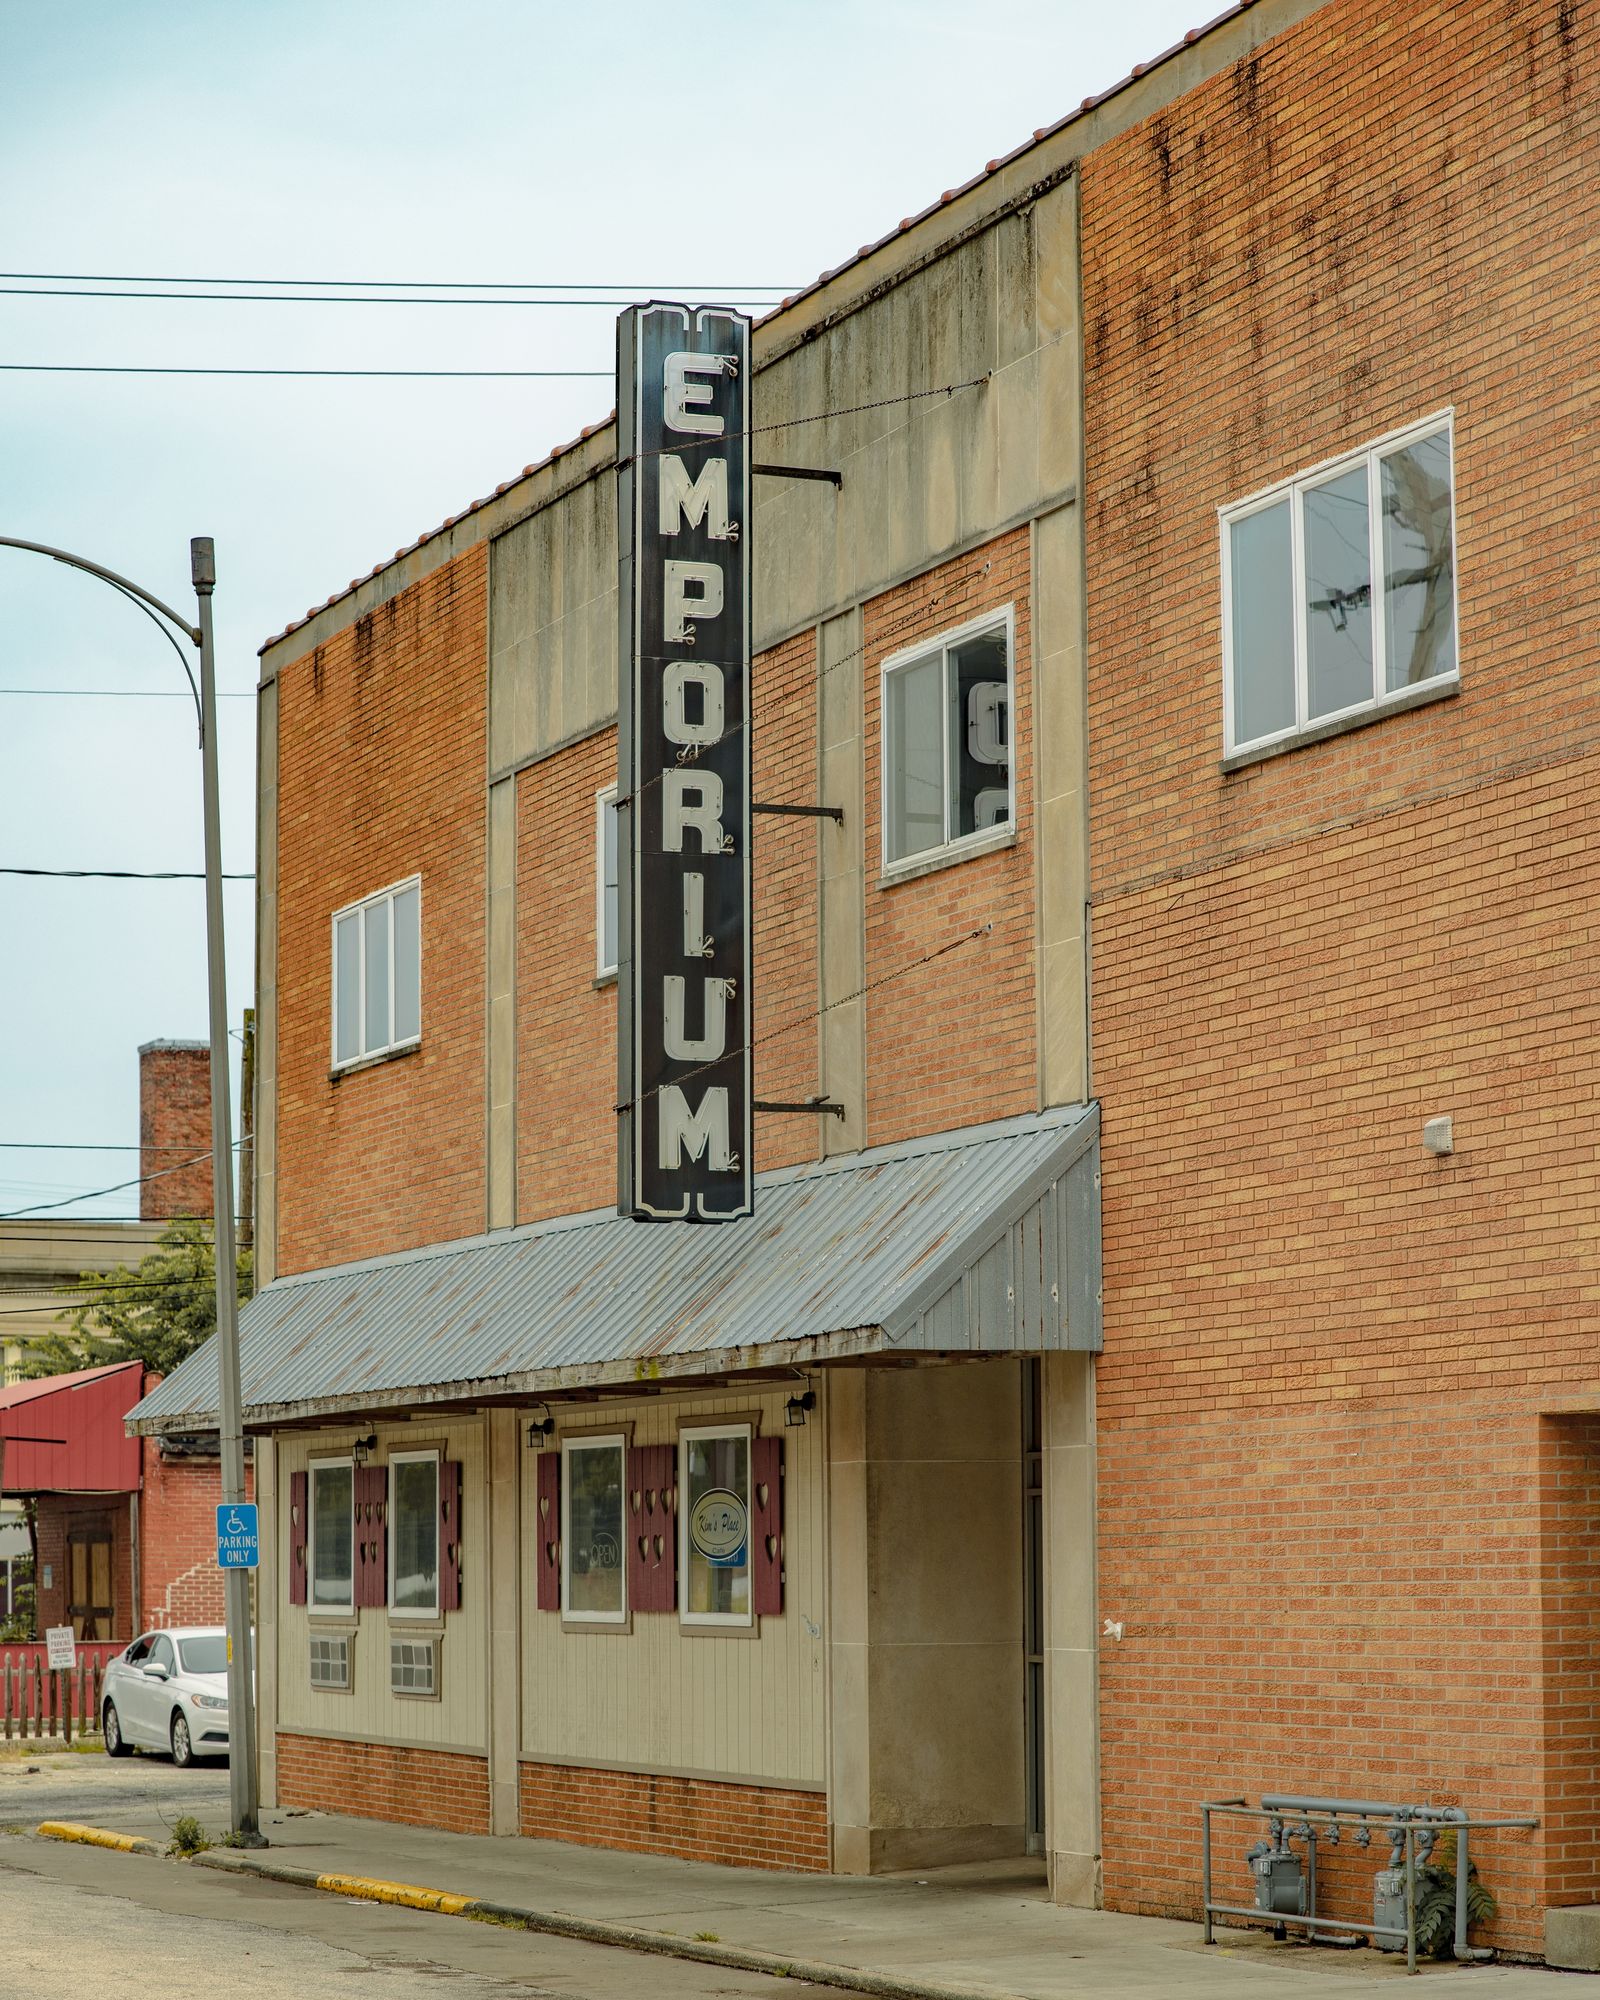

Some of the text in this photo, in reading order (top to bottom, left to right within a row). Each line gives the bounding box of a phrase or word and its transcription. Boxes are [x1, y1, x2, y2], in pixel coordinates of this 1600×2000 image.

[658, 351, 733, 1172] EMPORIUM
[720, 1512, 739, 1533] Place
[219, 1536, 256, 1548] PARKING
[227, 1550, 249, 1562] ONLY
[591, 1544, 615, 1564] OPEN
[50, 1631, 70, 1640] PRIVATE
